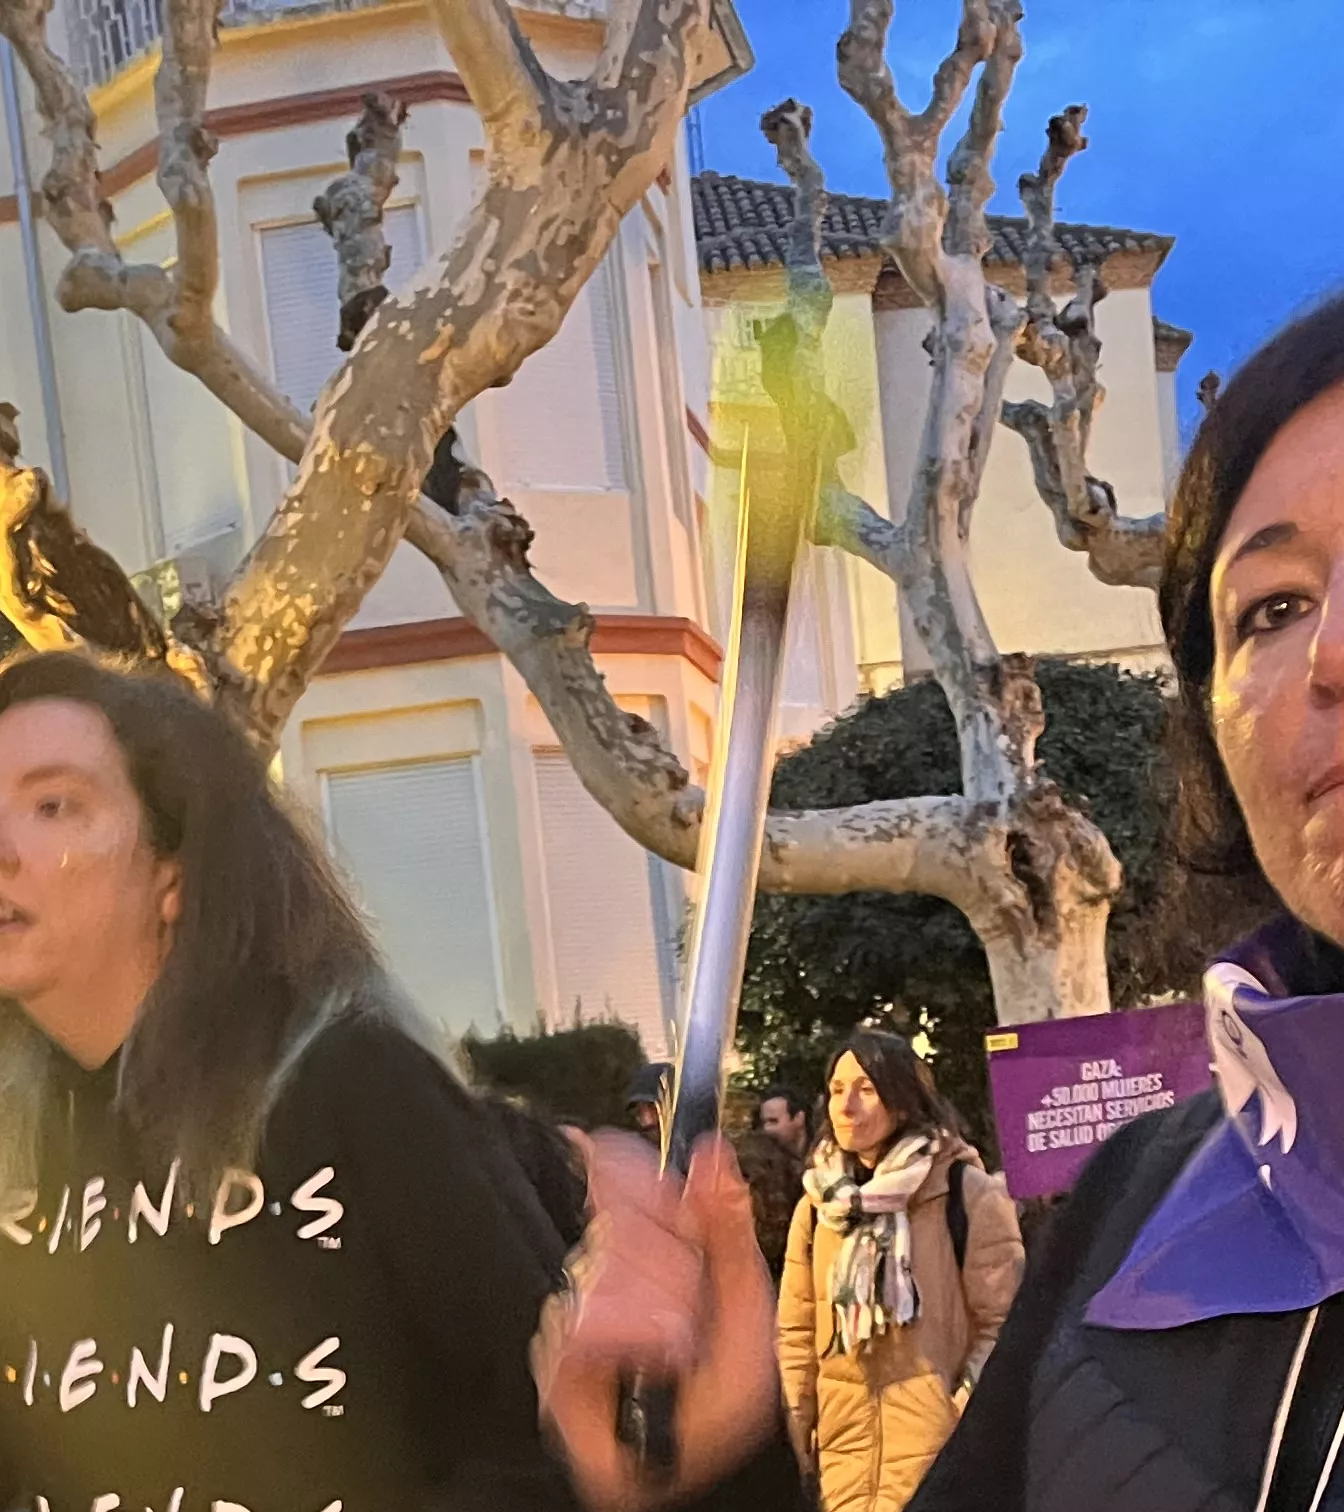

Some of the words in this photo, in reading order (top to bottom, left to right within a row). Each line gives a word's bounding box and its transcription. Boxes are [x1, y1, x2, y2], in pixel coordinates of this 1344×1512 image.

[1081, 1058, 1123, 1081] GAZA:
[1041, 1083, 1099, 1107] +50.000
[1101, 1072, 1164, 1100] MUJERES
[1027, 1102, 1103, 1131] NECESITAN
[1105, 1090, 1176, 1121] SERVICIOS
[1027, 1131, 1048, 1153] DE
[1049, 1124, 1095, 1150] SALUD
